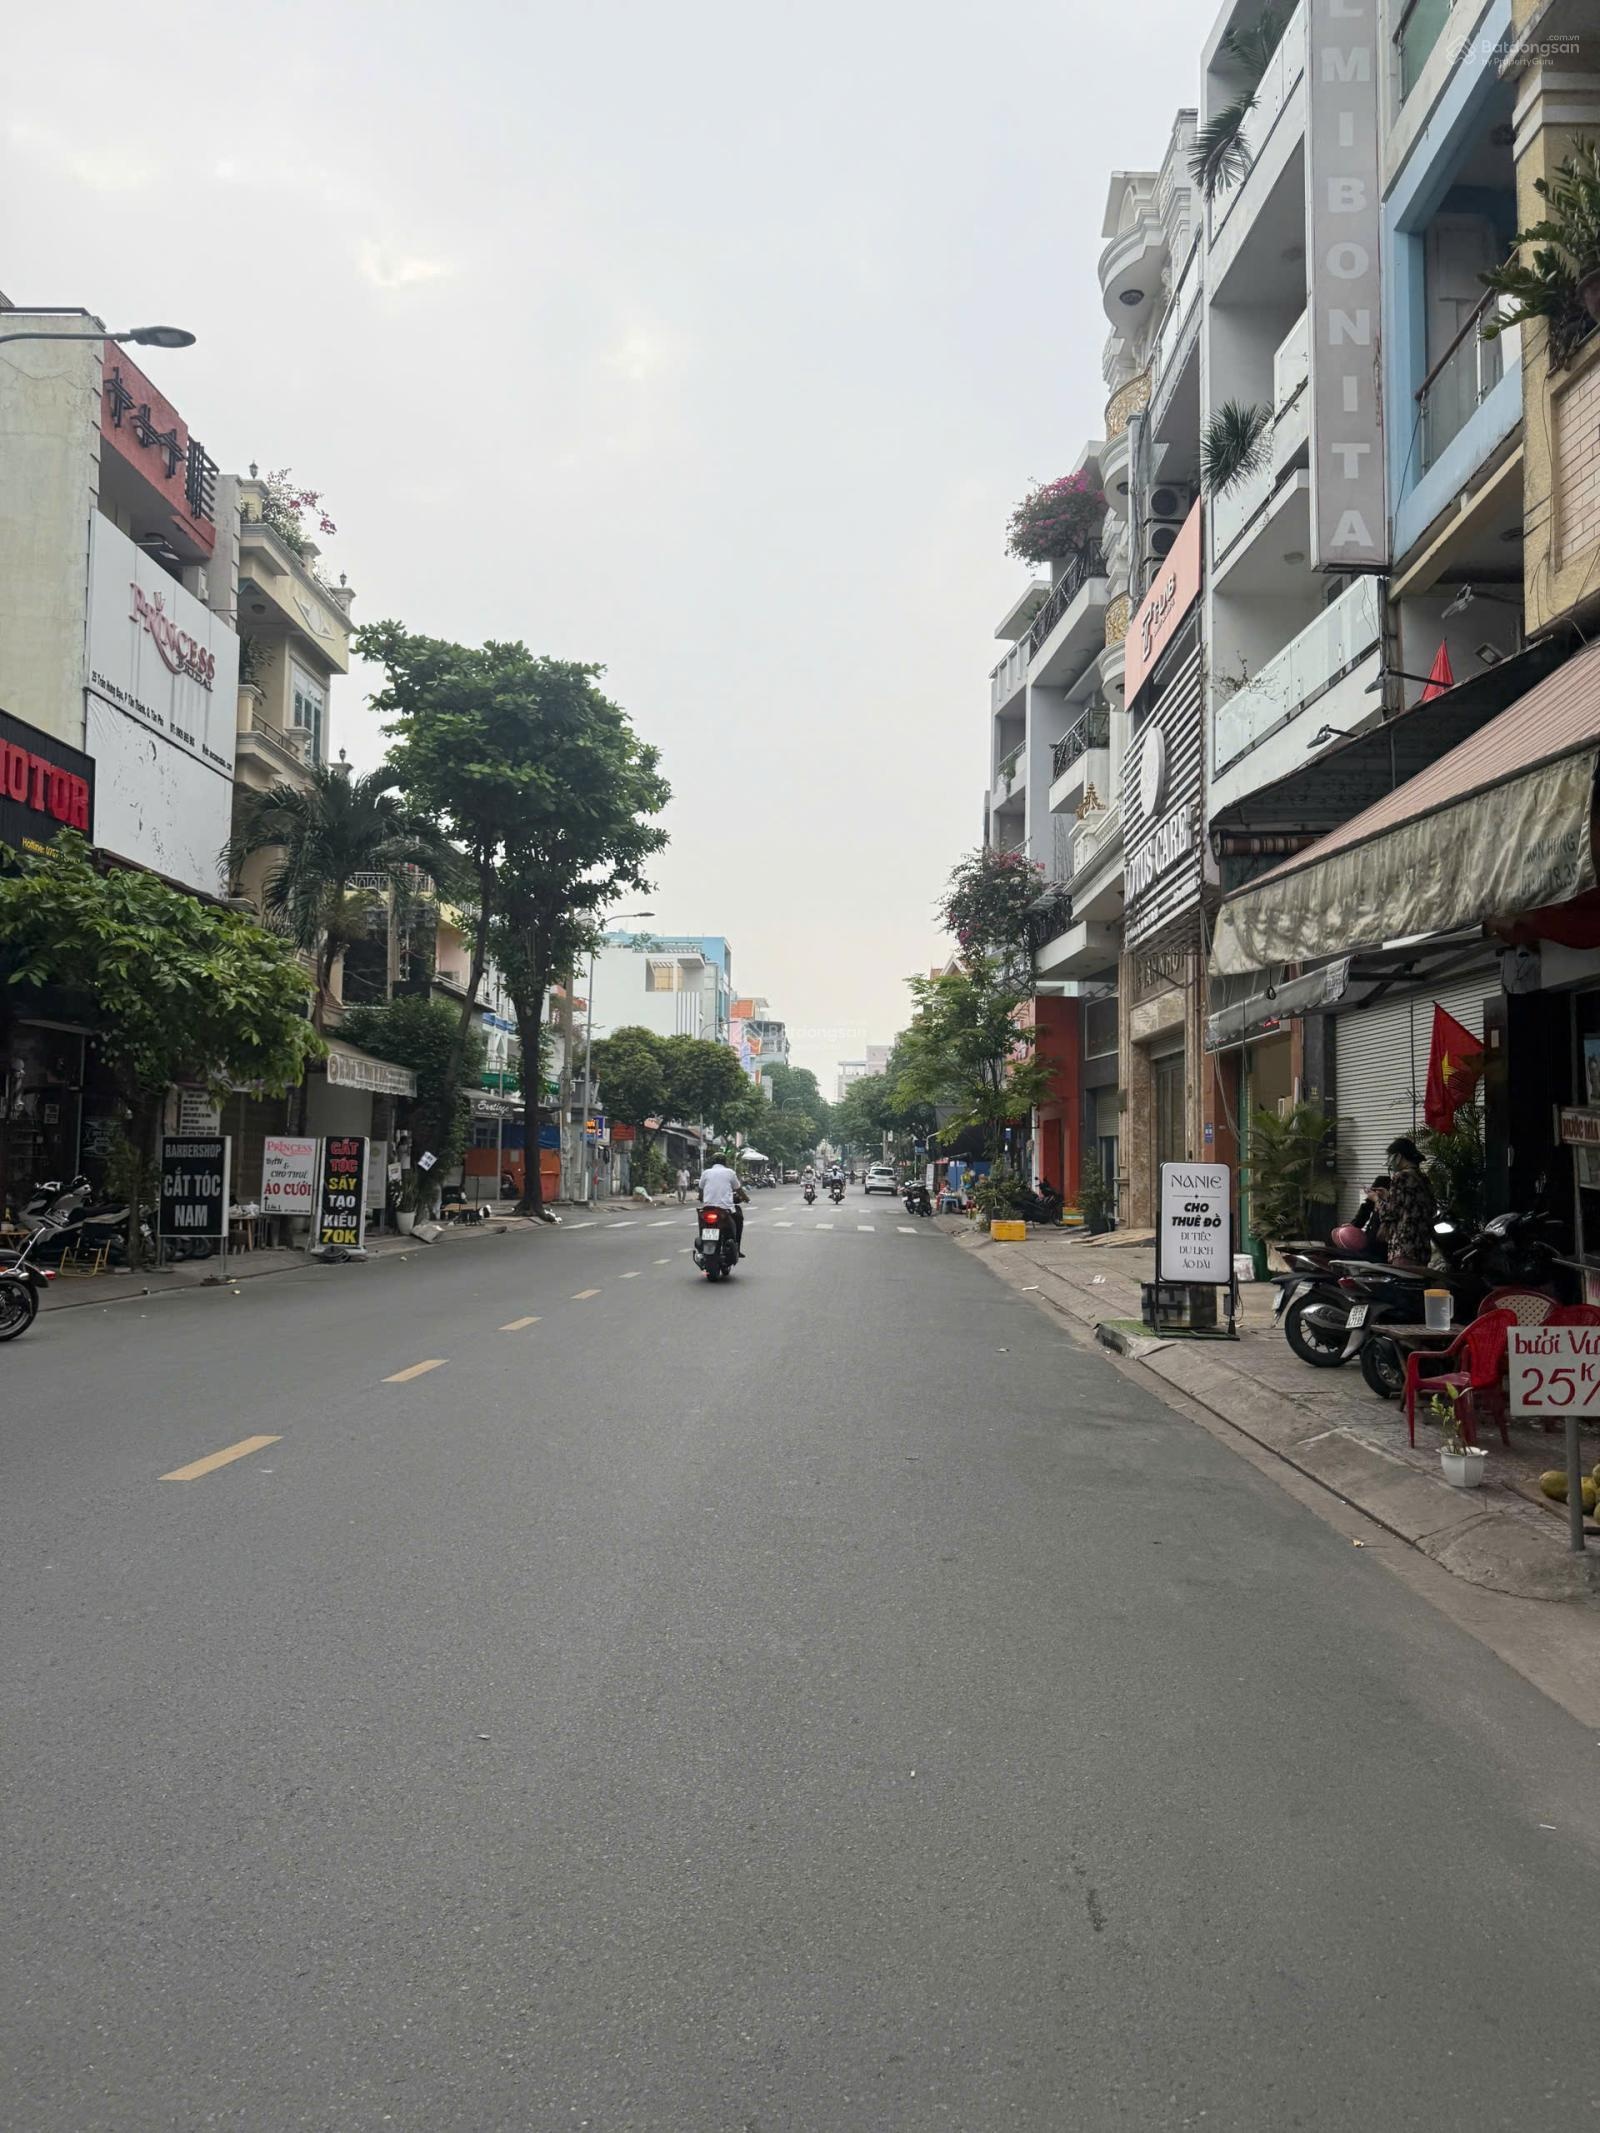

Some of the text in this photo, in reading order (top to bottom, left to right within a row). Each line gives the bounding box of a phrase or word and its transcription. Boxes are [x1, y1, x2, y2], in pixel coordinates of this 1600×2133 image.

[0, 737, 89, 831] OTOR
[1155, 803, 1192, 876] CARE
[165, 1144, 222, 1158] BARBERSHOP
[329, 1138, 359, 1155] CẮT
[330, 1156, 358, 1173] TÓC
[163, 1167, 221, 1197] CẮT TÓC
[264, 1178, 312, 1196] ÁO CƯỚI
[328, 1174, 357, 1190] SẤY
[1171, 1174, 1222, 1189] NANIE
[328, 1195, 356, 1210] TẠO
[1184, 1202, 1209, 1213] CHO
[174, 1205, 208, 1227] NAM
[323, 1210, 357, 1227] KIỂU
[1171, 1213, 1222, 1227] THUÊ ĐỒ
[322, 1229, 357, 1244] 70K
[1515, 1328, 1562, 1354] bưởi
